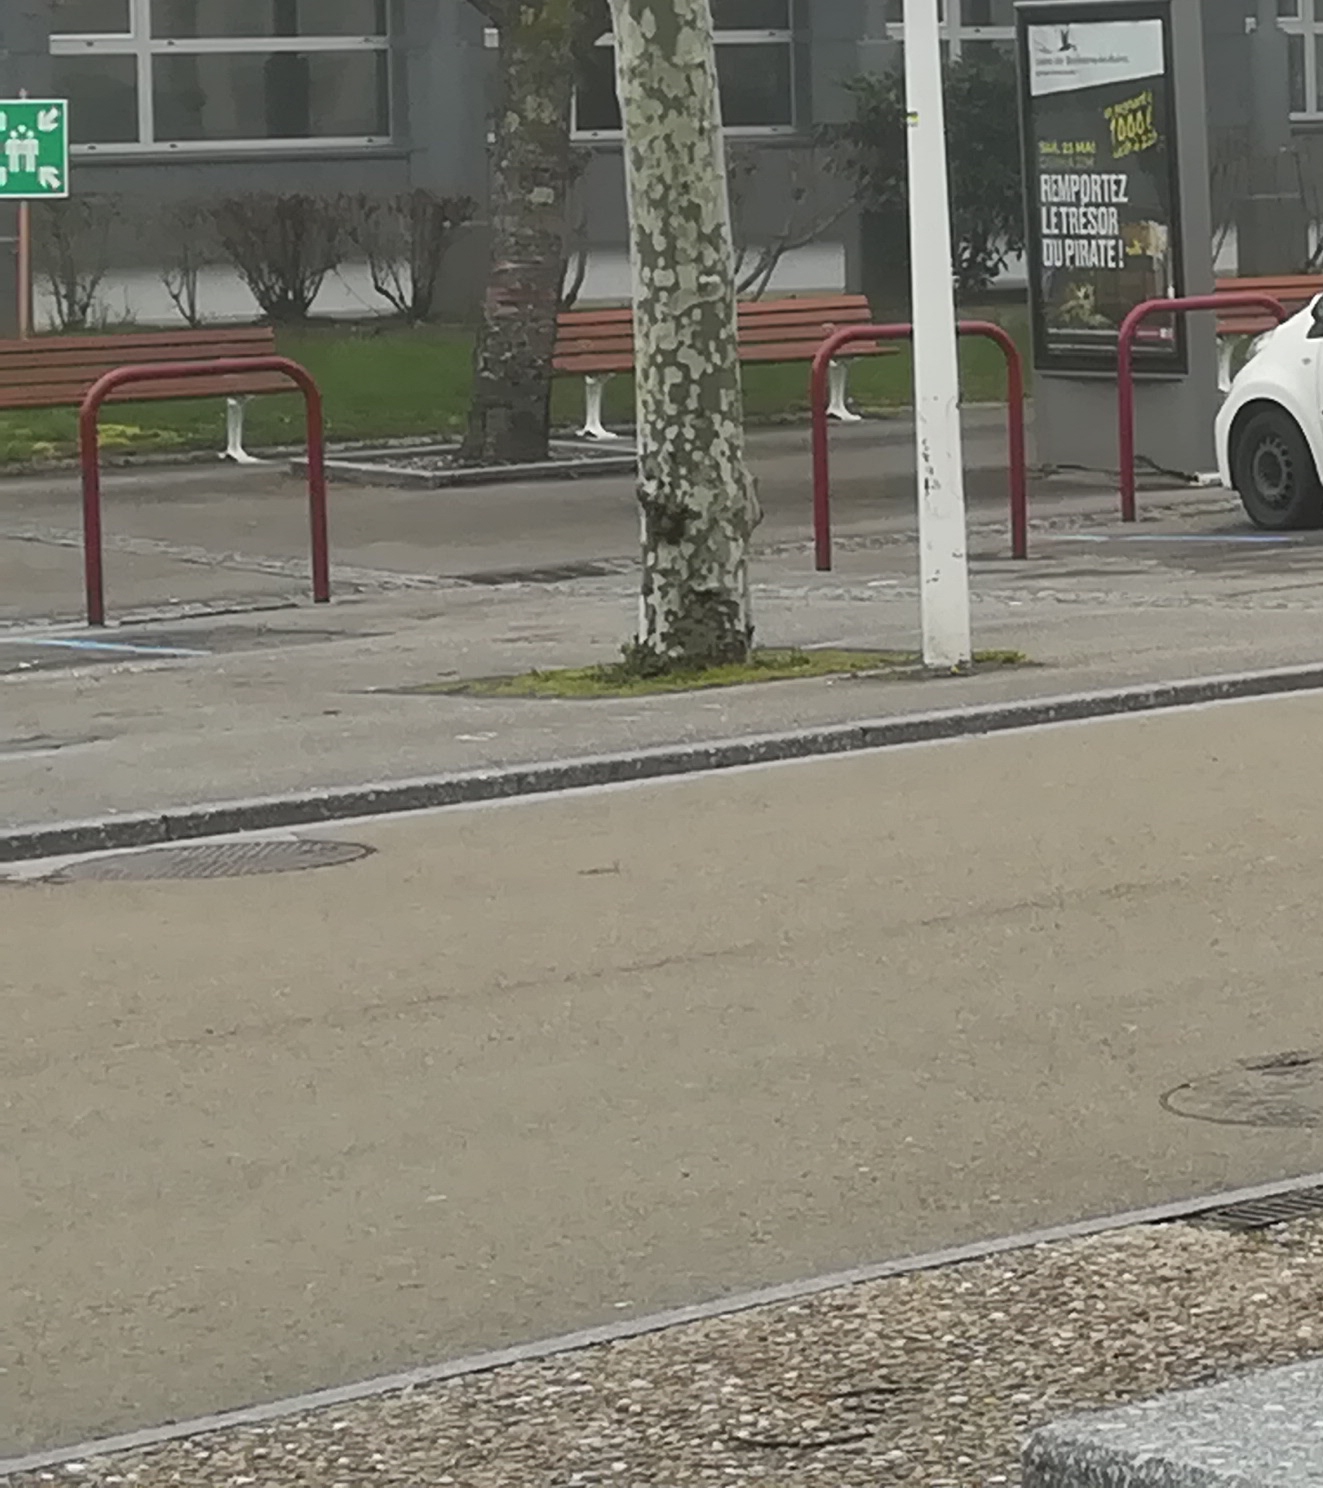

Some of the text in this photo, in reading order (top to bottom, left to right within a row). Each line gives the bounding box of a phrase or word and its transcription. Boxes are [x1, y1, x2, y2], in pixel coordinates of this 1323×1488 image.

[1040, 174, 1128, 203] REMPORTEZ
[1042, 202, 1119, 235] LE TRÉSOR
[1042, 239, 1063, 268] DU
